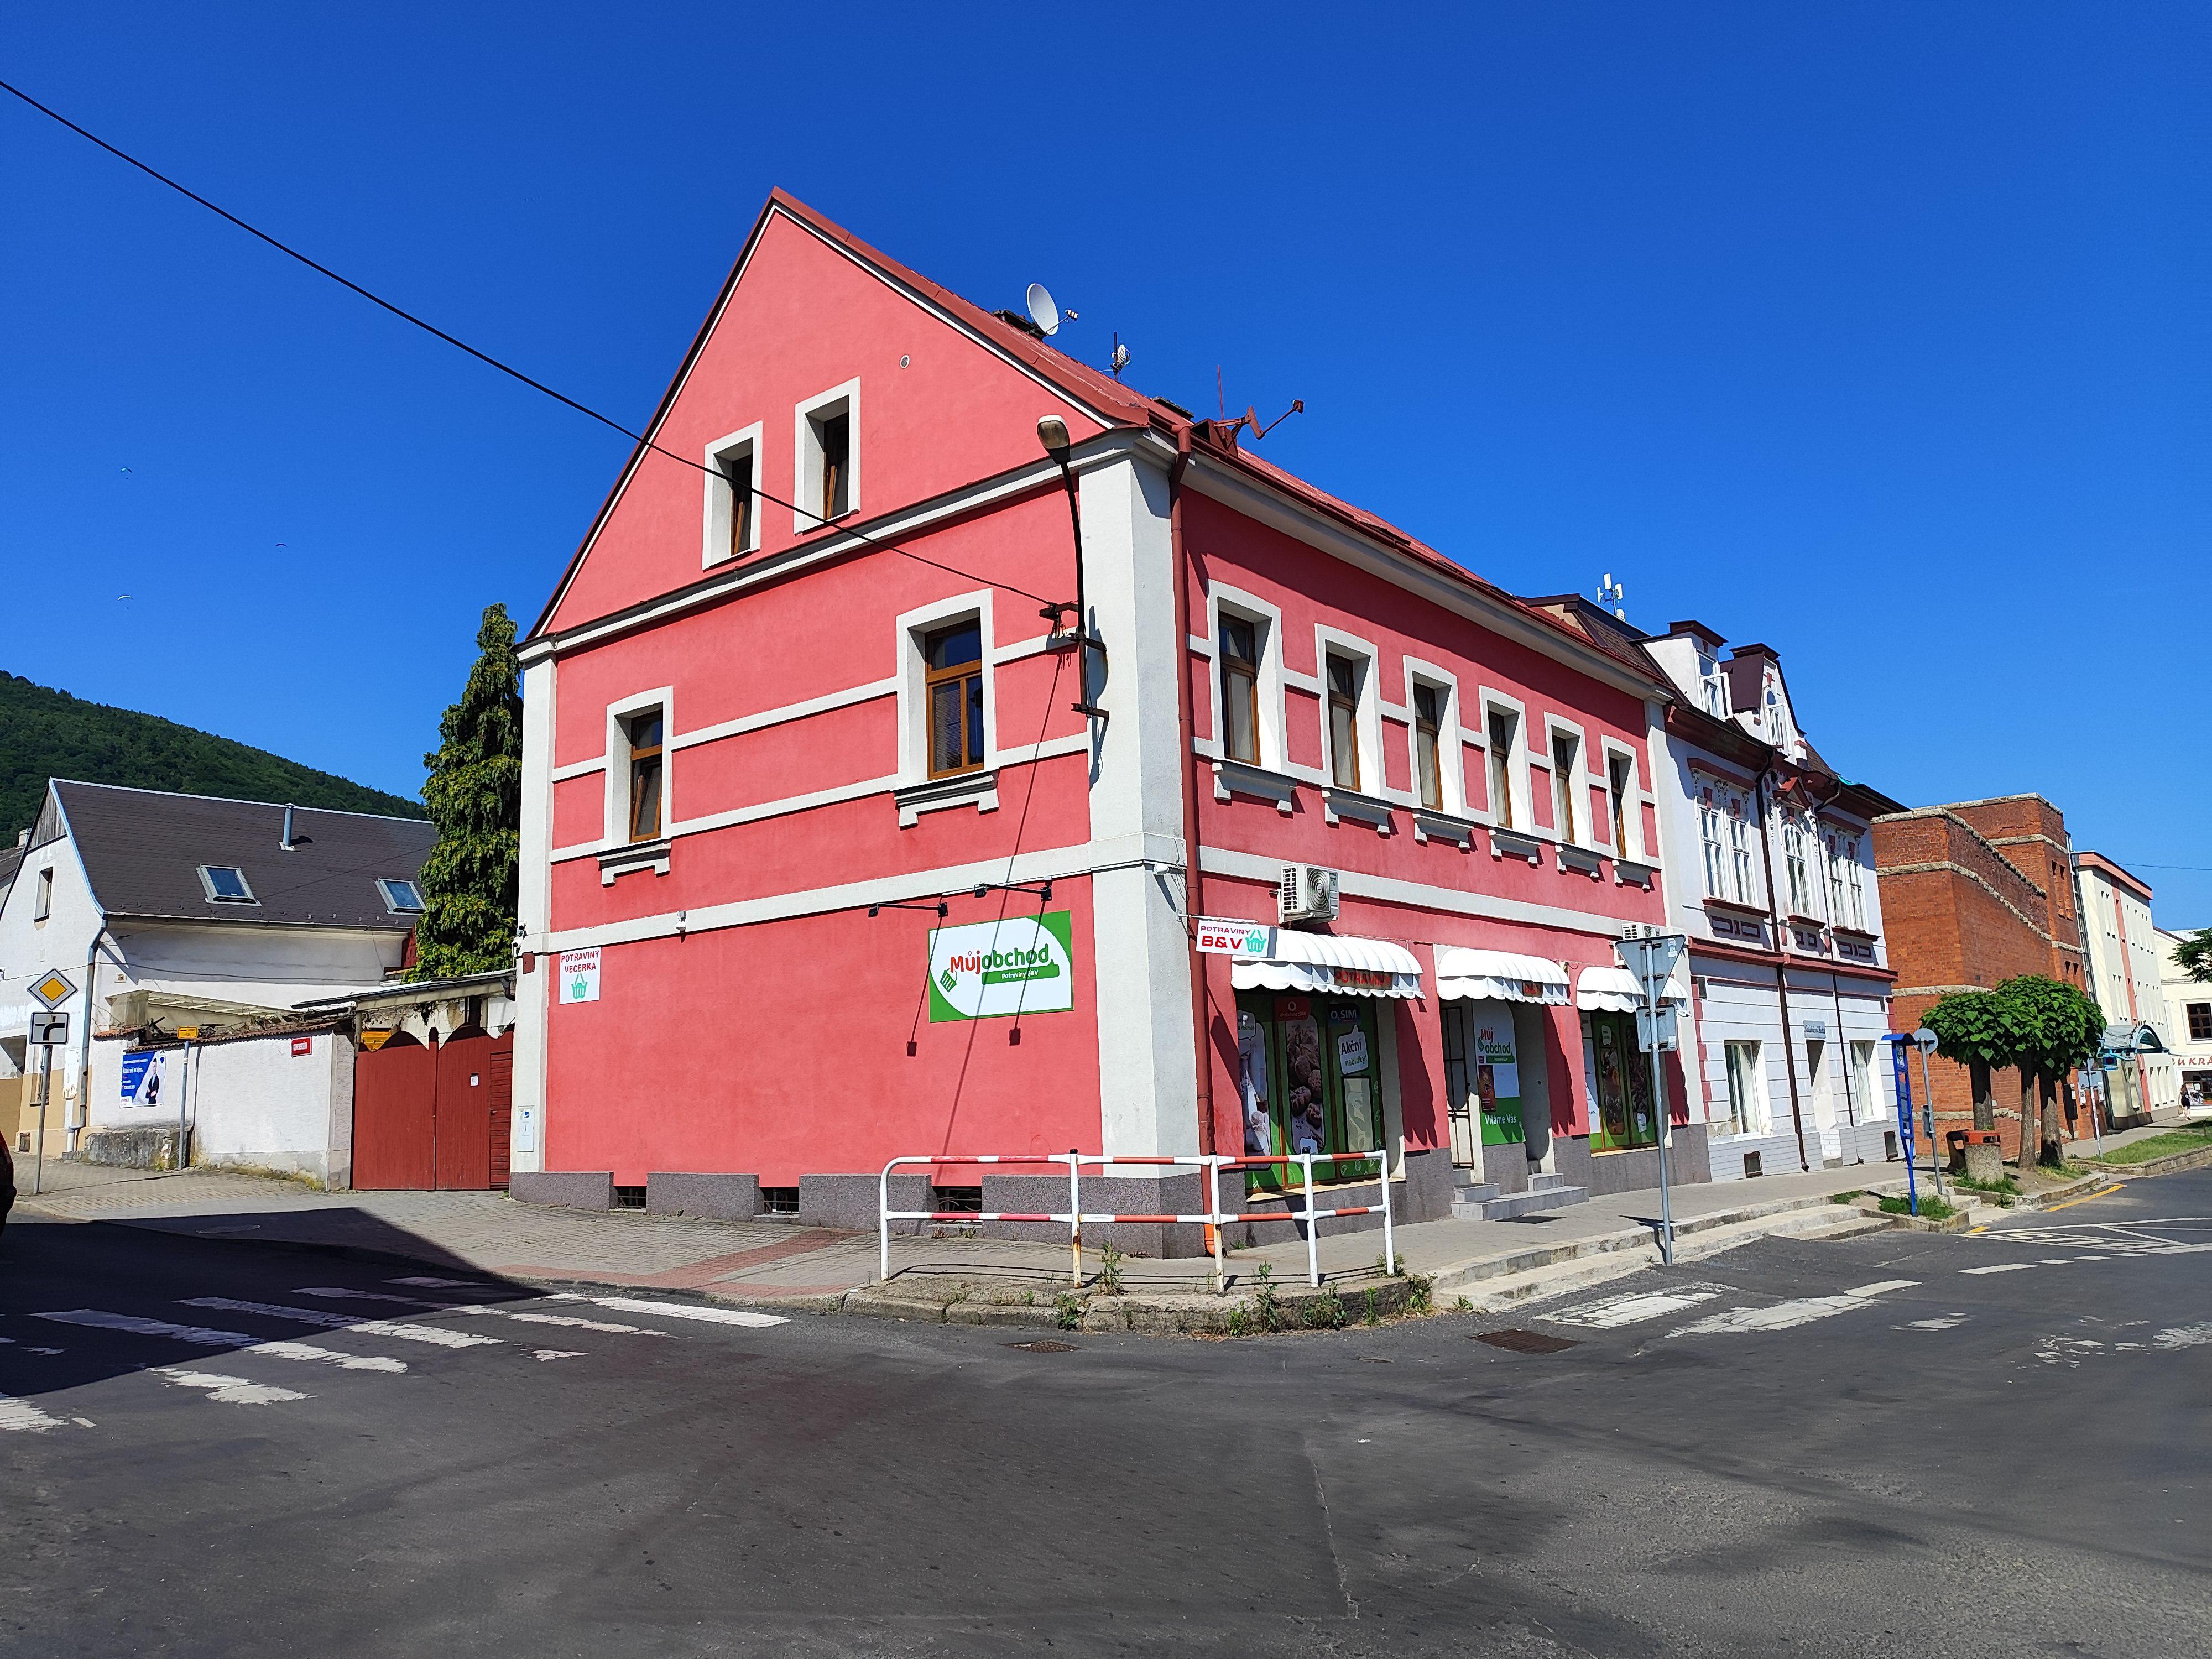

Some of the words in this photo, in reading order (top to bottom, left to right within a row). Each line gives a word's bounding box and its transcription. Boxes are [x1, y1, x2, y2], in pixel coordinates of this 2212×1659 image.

[1201, 926, 1250, 935] POTRAVINY
[1202, 935, 1243, 950] B&V
[561, 950, 599, 963] POTRAVINY
[565, 962, 596, 974] VEČERKA
[1001, 971, 1026, 979] Potraviny
[1340, 1009, 1357, 1019] SIM
[1480, 1027, 1493, 1043] Můj
[1340, 1038, 1363, 1055] Akční
[1485, 1042, 1511, 1054] obchod
[1506, 1113, 1517, 1124] Vás
